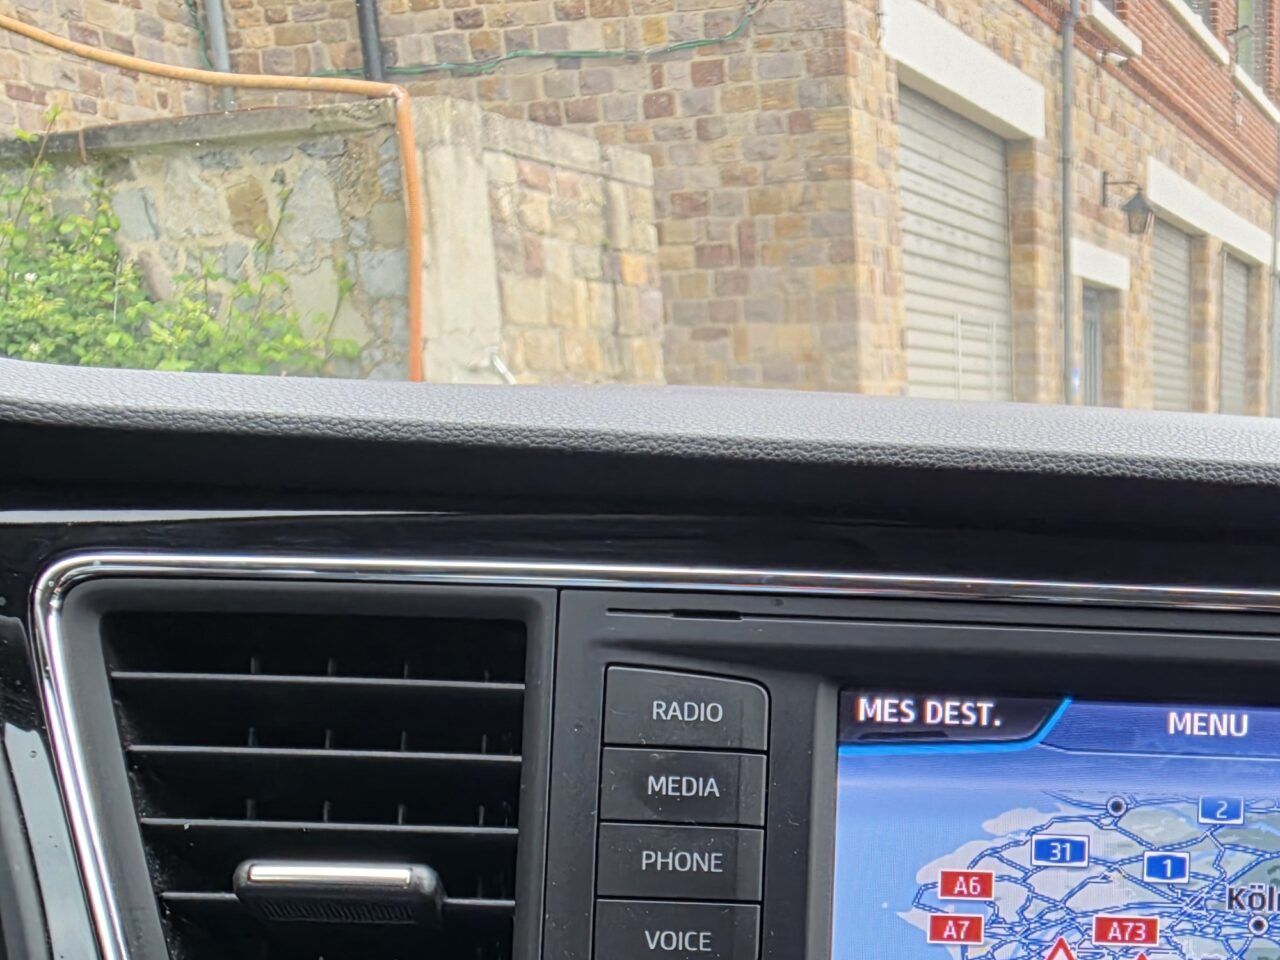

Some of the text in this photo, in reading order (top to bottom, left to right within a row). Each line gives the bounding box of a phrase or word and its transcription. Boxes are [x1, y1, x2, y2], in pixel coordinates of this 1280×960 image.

[652, 700, 723, 722] RADIO
[858, 697, 1002, 727] MES DEST.
[1169, 712, 1248, 738] MENU
[647, 775, 720, 797] MEDIA
[1215, 801, 1228, 820] 2
[641, 850, 723, 873] PHONE
[1049, 842, 1072, 862] 31
[954, 876, 981, 896] A6
[645, 929, 713, 951] VOICE
[943, 920, 969, 940] A7
[1107, 922, 1146, 942] A73
